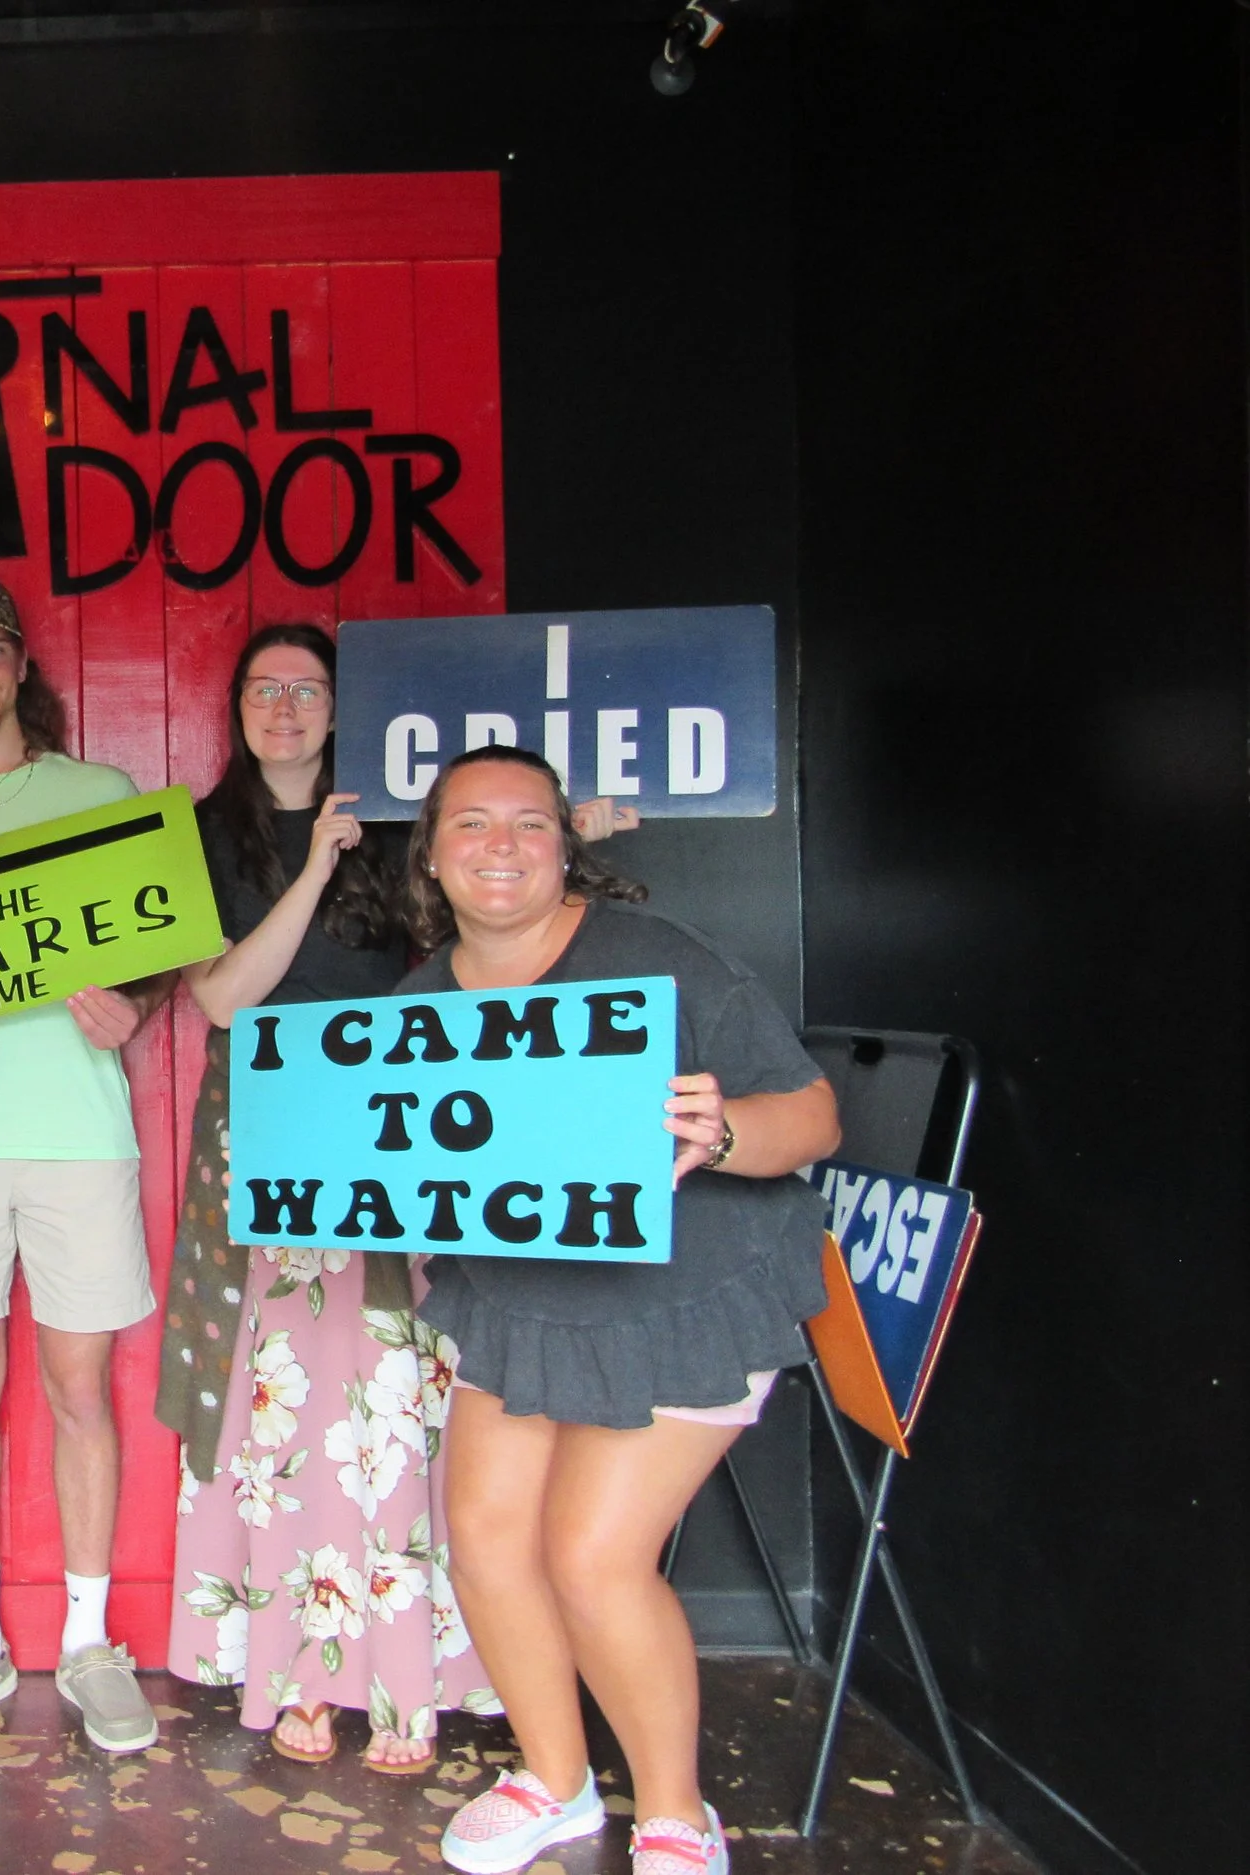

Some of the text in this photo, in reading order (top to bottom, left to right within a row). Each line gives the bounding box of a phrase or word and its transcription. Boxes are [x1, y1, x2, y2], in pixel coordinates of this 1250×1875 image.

[46, 433, 483, 595] DOOR
[546, 625, 569, 699] I
[250, 990, 648, 1071] I CAME
[367, 1090, 494, 1152] TO
[246, 1178, 647, 1248] WATCH
